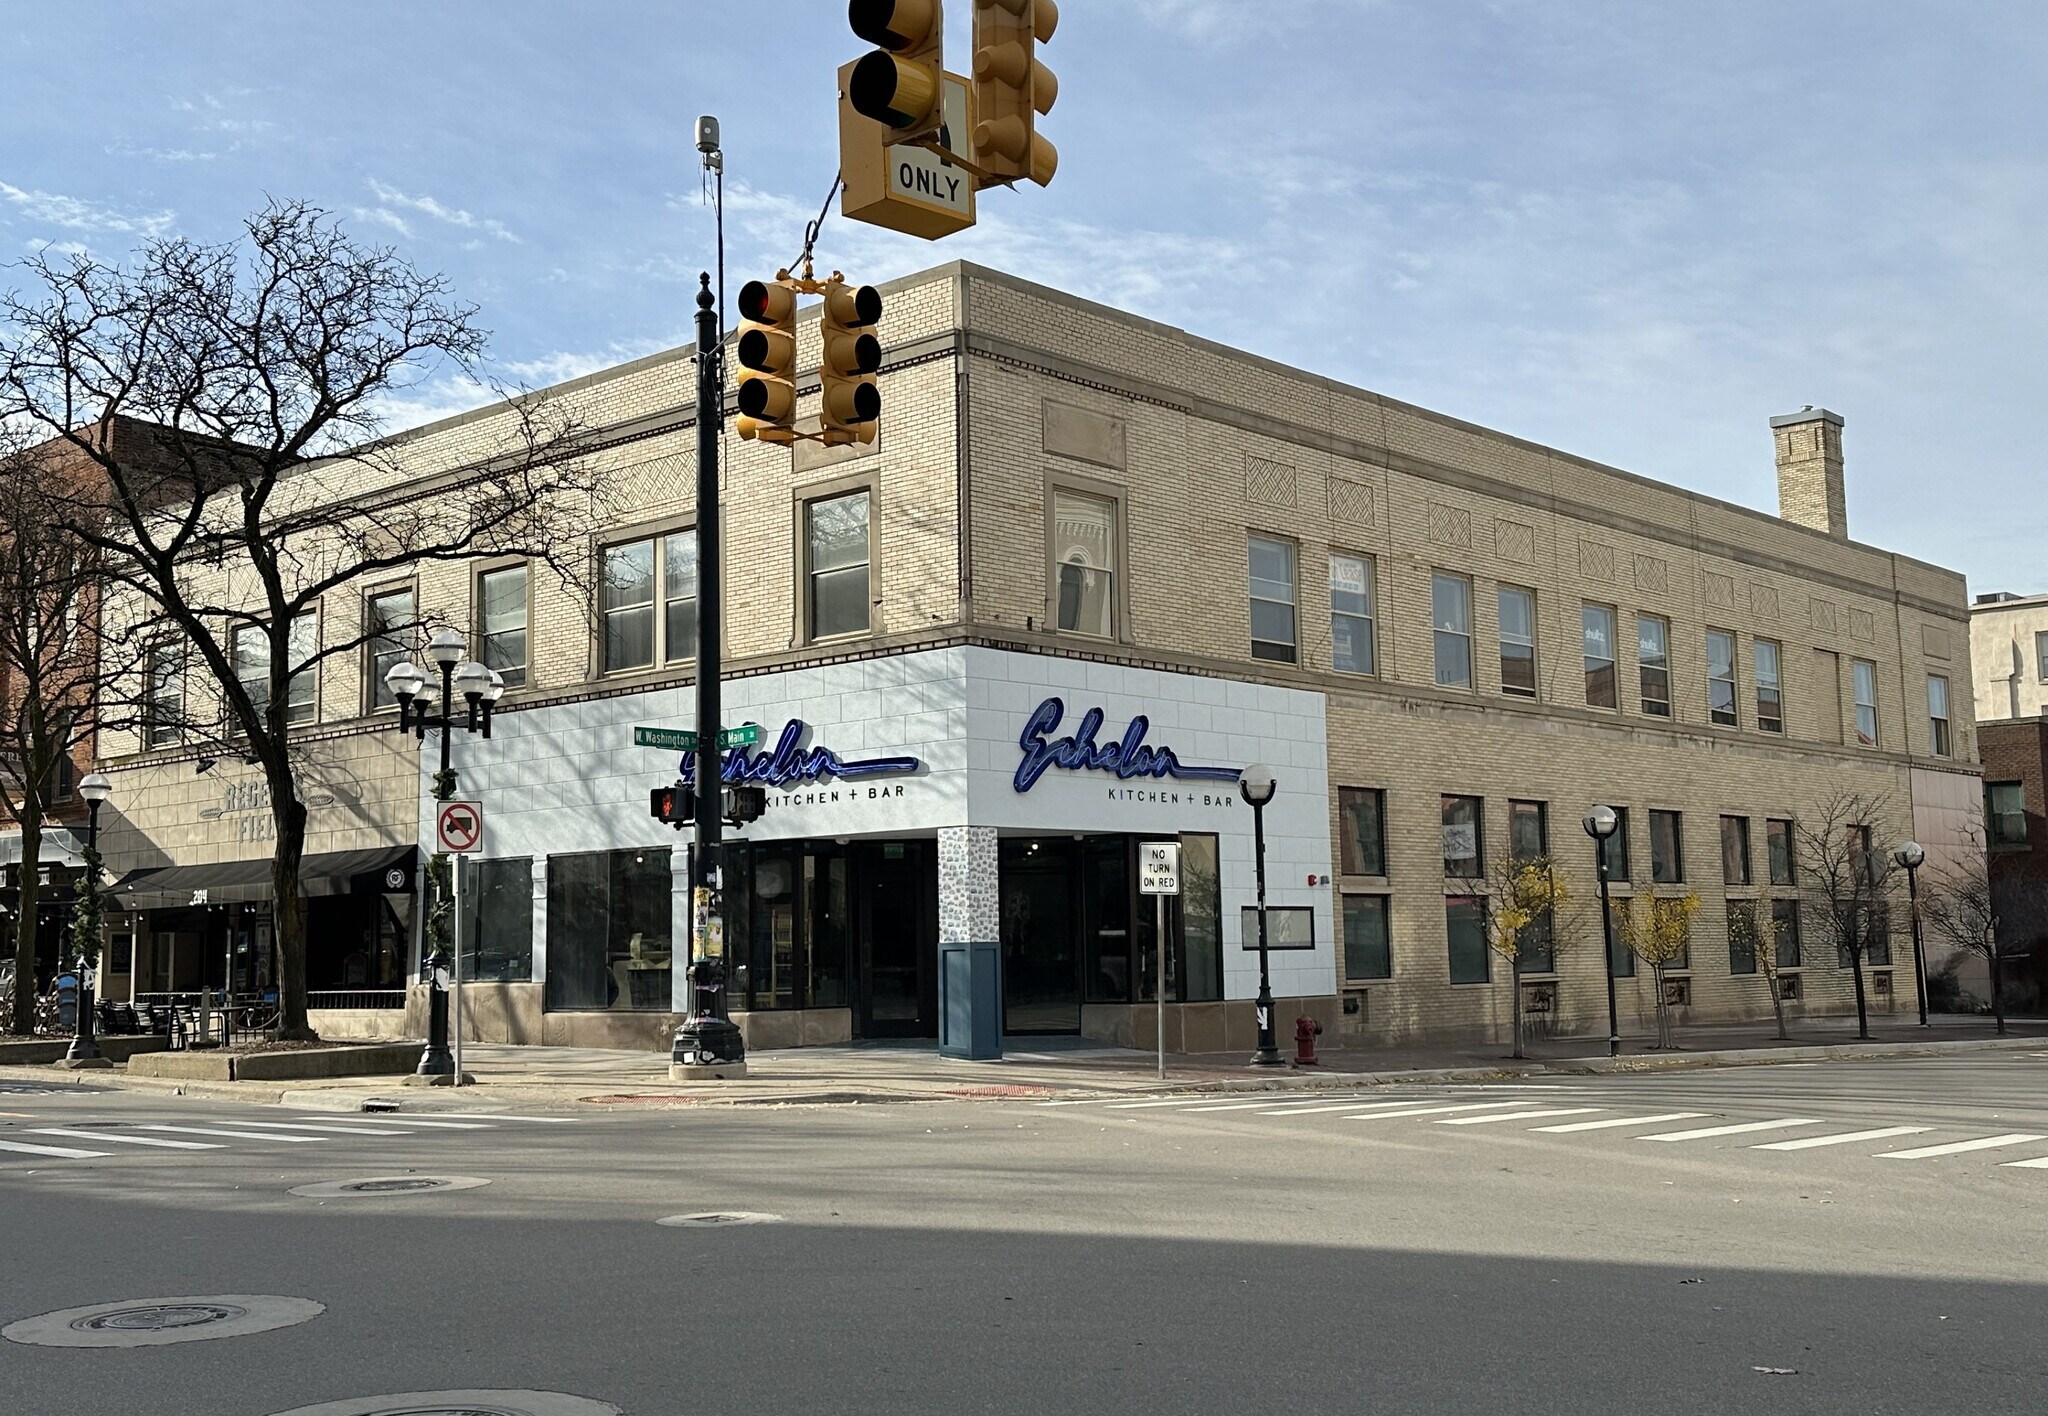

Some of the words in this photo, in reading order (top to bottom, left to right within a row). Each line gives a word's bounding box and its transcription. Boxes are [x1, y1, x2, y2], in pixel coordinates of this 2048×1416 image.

[899, 162, 960, 202] ONLY
[635, 730, 643, 743] W.
[645, 730, 690, 749] Washington
[728, 732, 745, 744] Main
[1013, 696, 1244, 793] Echelon
[765, 790, 839, 808] KITCHEN
[868, 785, 905, 799] BAR
[1108, 788, 1179, 804] KITCHEN
[1204, 795, 1233, 807] BAR
[239, 813, 276, 843] FIEL
[1152, 849, 1166, 860] NO
[1148, 864, 1170, 874] TURN
[1143, 877, 1155, 887] ON
[1159, 877, 1175, 888] RED
[193, 889, 208, 904] 204
